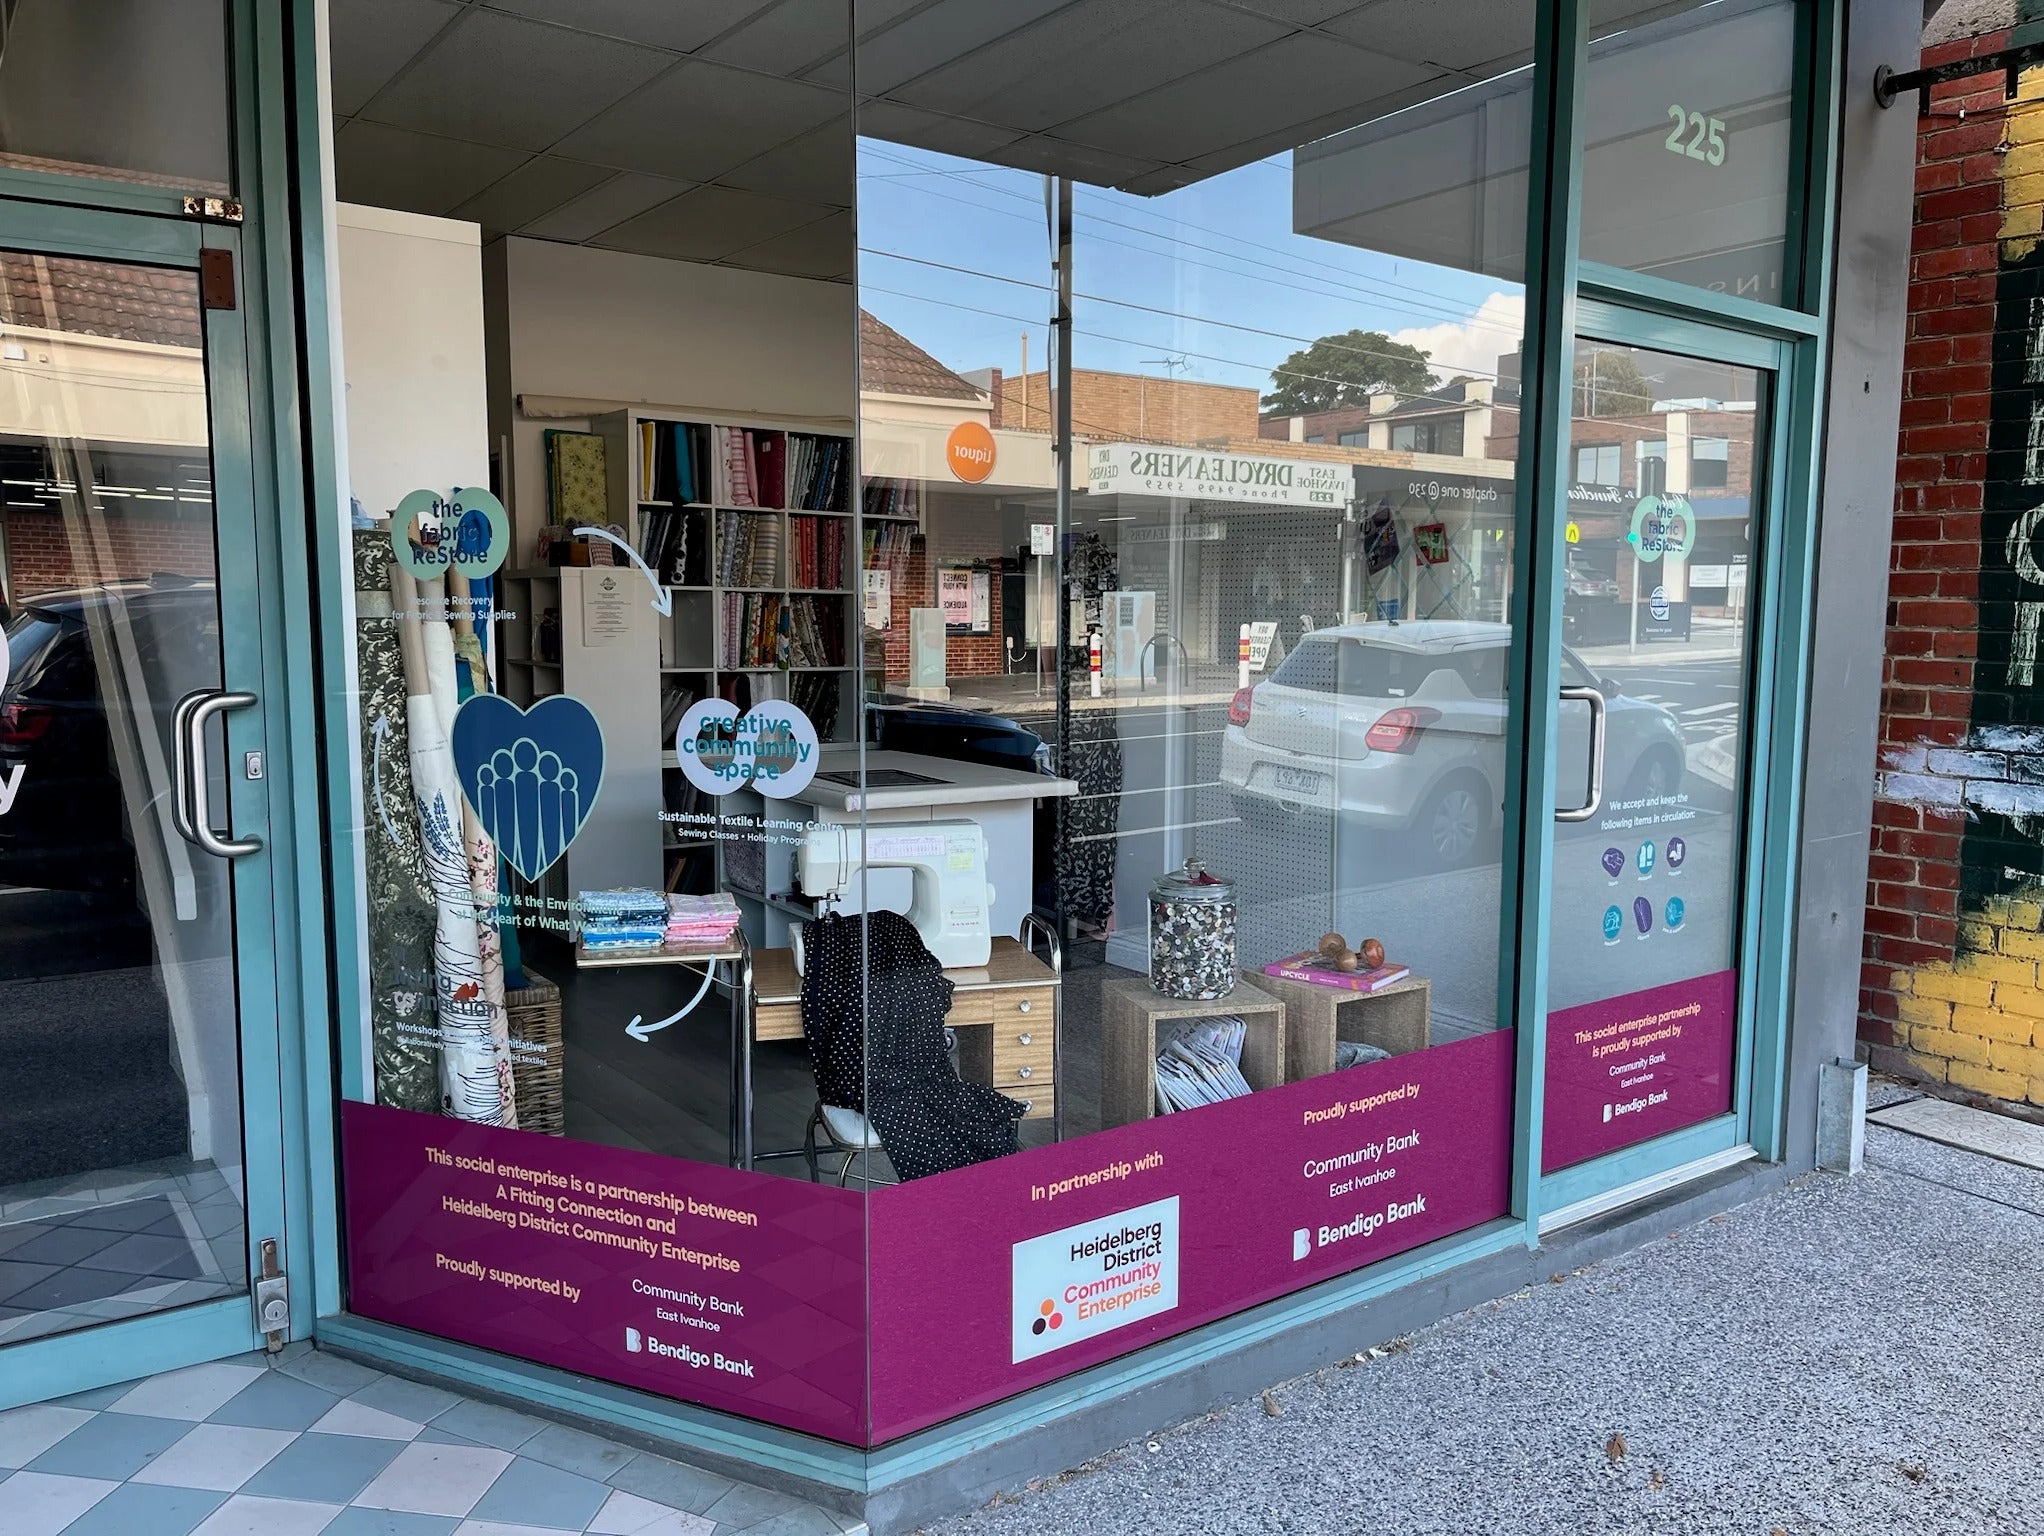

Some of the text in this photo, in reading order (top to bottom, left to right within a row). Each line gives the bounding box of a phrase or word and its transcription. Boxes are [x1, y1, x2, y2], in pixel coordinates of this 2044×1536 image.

[1665, 104, 1726, 166] 225
[432, 499, 463, 518] the
[1656, 504, 1673, 518] the
[419, 522, 480, 543] fabric
[1647, 520, 1679, 535] fabric
[413, 545, 488, 565] ReStore
[1641, 537, 1684, 552] ReStore
[452, 595, 492, 607] Recovery
[392, 609, 405, 620] for
[444, 610, 476, 622] Sewing
[478, 609, 517, 622] Suplies
[700, 714, 792, 734] creative
[683, 737, 812, 762] community
[714, 761, 780, 781] space
[1609, 793, 1689, 811] We accept and keep the
[658, 810, 843, 832] Sustainable Textile Learning Centre
[1601, 810, 1696, 831] following items in circulation:
[678, 828, 708, 840] Sewing
[709, 829, 739, 841] Classes
[747, 832, 778, 844] Holiday
[514, 894, 522, 906] &
[525, 894, 544, 908] the
[491, 908, 522, 927] Heart
[524, 915, 536, 927] of
[538, 916, 570, 930] What
[1280, 969, 1310, 981] UPCYCLE
[396, 1021, 444, 1037] Workshops
[1574, 1002, 1701, 1045] This social enterprise partnership
[505, 1039, 548, 1053] nitiatives
[1592, 1024, 1682, 1059] is proudly supported by
[521, 1054, 548, 1066] textiles
[1609, 1051, 1666, 1077] Community Bank
[1620, 1071, 1654, 1088] East Ivanhoe
[1303, 1082, 1420, 1126] Proudly supported by
[1614, 1095, 1647, 1116] Bendigo
[1648, 1089, 1669, 1104] Bank
[1303, 1128, 1420, 1179] Community Bank
[425, 1147, 758, 1226] This social enterprise is a partnership between
[1031, 1150, 1164, 1201] In partnership with
[1329, 1167, 1396, 1198] East Ivanhoe
[496, 1183, 676, 1235] A Fitting Connection and
[1317, 1212, 1384, 1247] Bendigo
[1387, 1193, 1426, 1223] Bank
[442, 1195, 741, 1273] Heidelberg District Community Enterprise
[1070, 1221, 1161, 1261] Heidelberg
[1103, 1239, 1162, 1272] District
[435, 1253, 581, 1303] Proudly supported by
[1064, 1261, 1161, 1304] Community
[632, 1278, 745, 1317] Community Bank
[1078, 1281, 1161, 1320] Enterprise
[656, 1307, 721, 1333] East Ivanhoe
[648, 1336, 711, 1368] Bendigo
[713, 1352, 755, 1378] Bank
